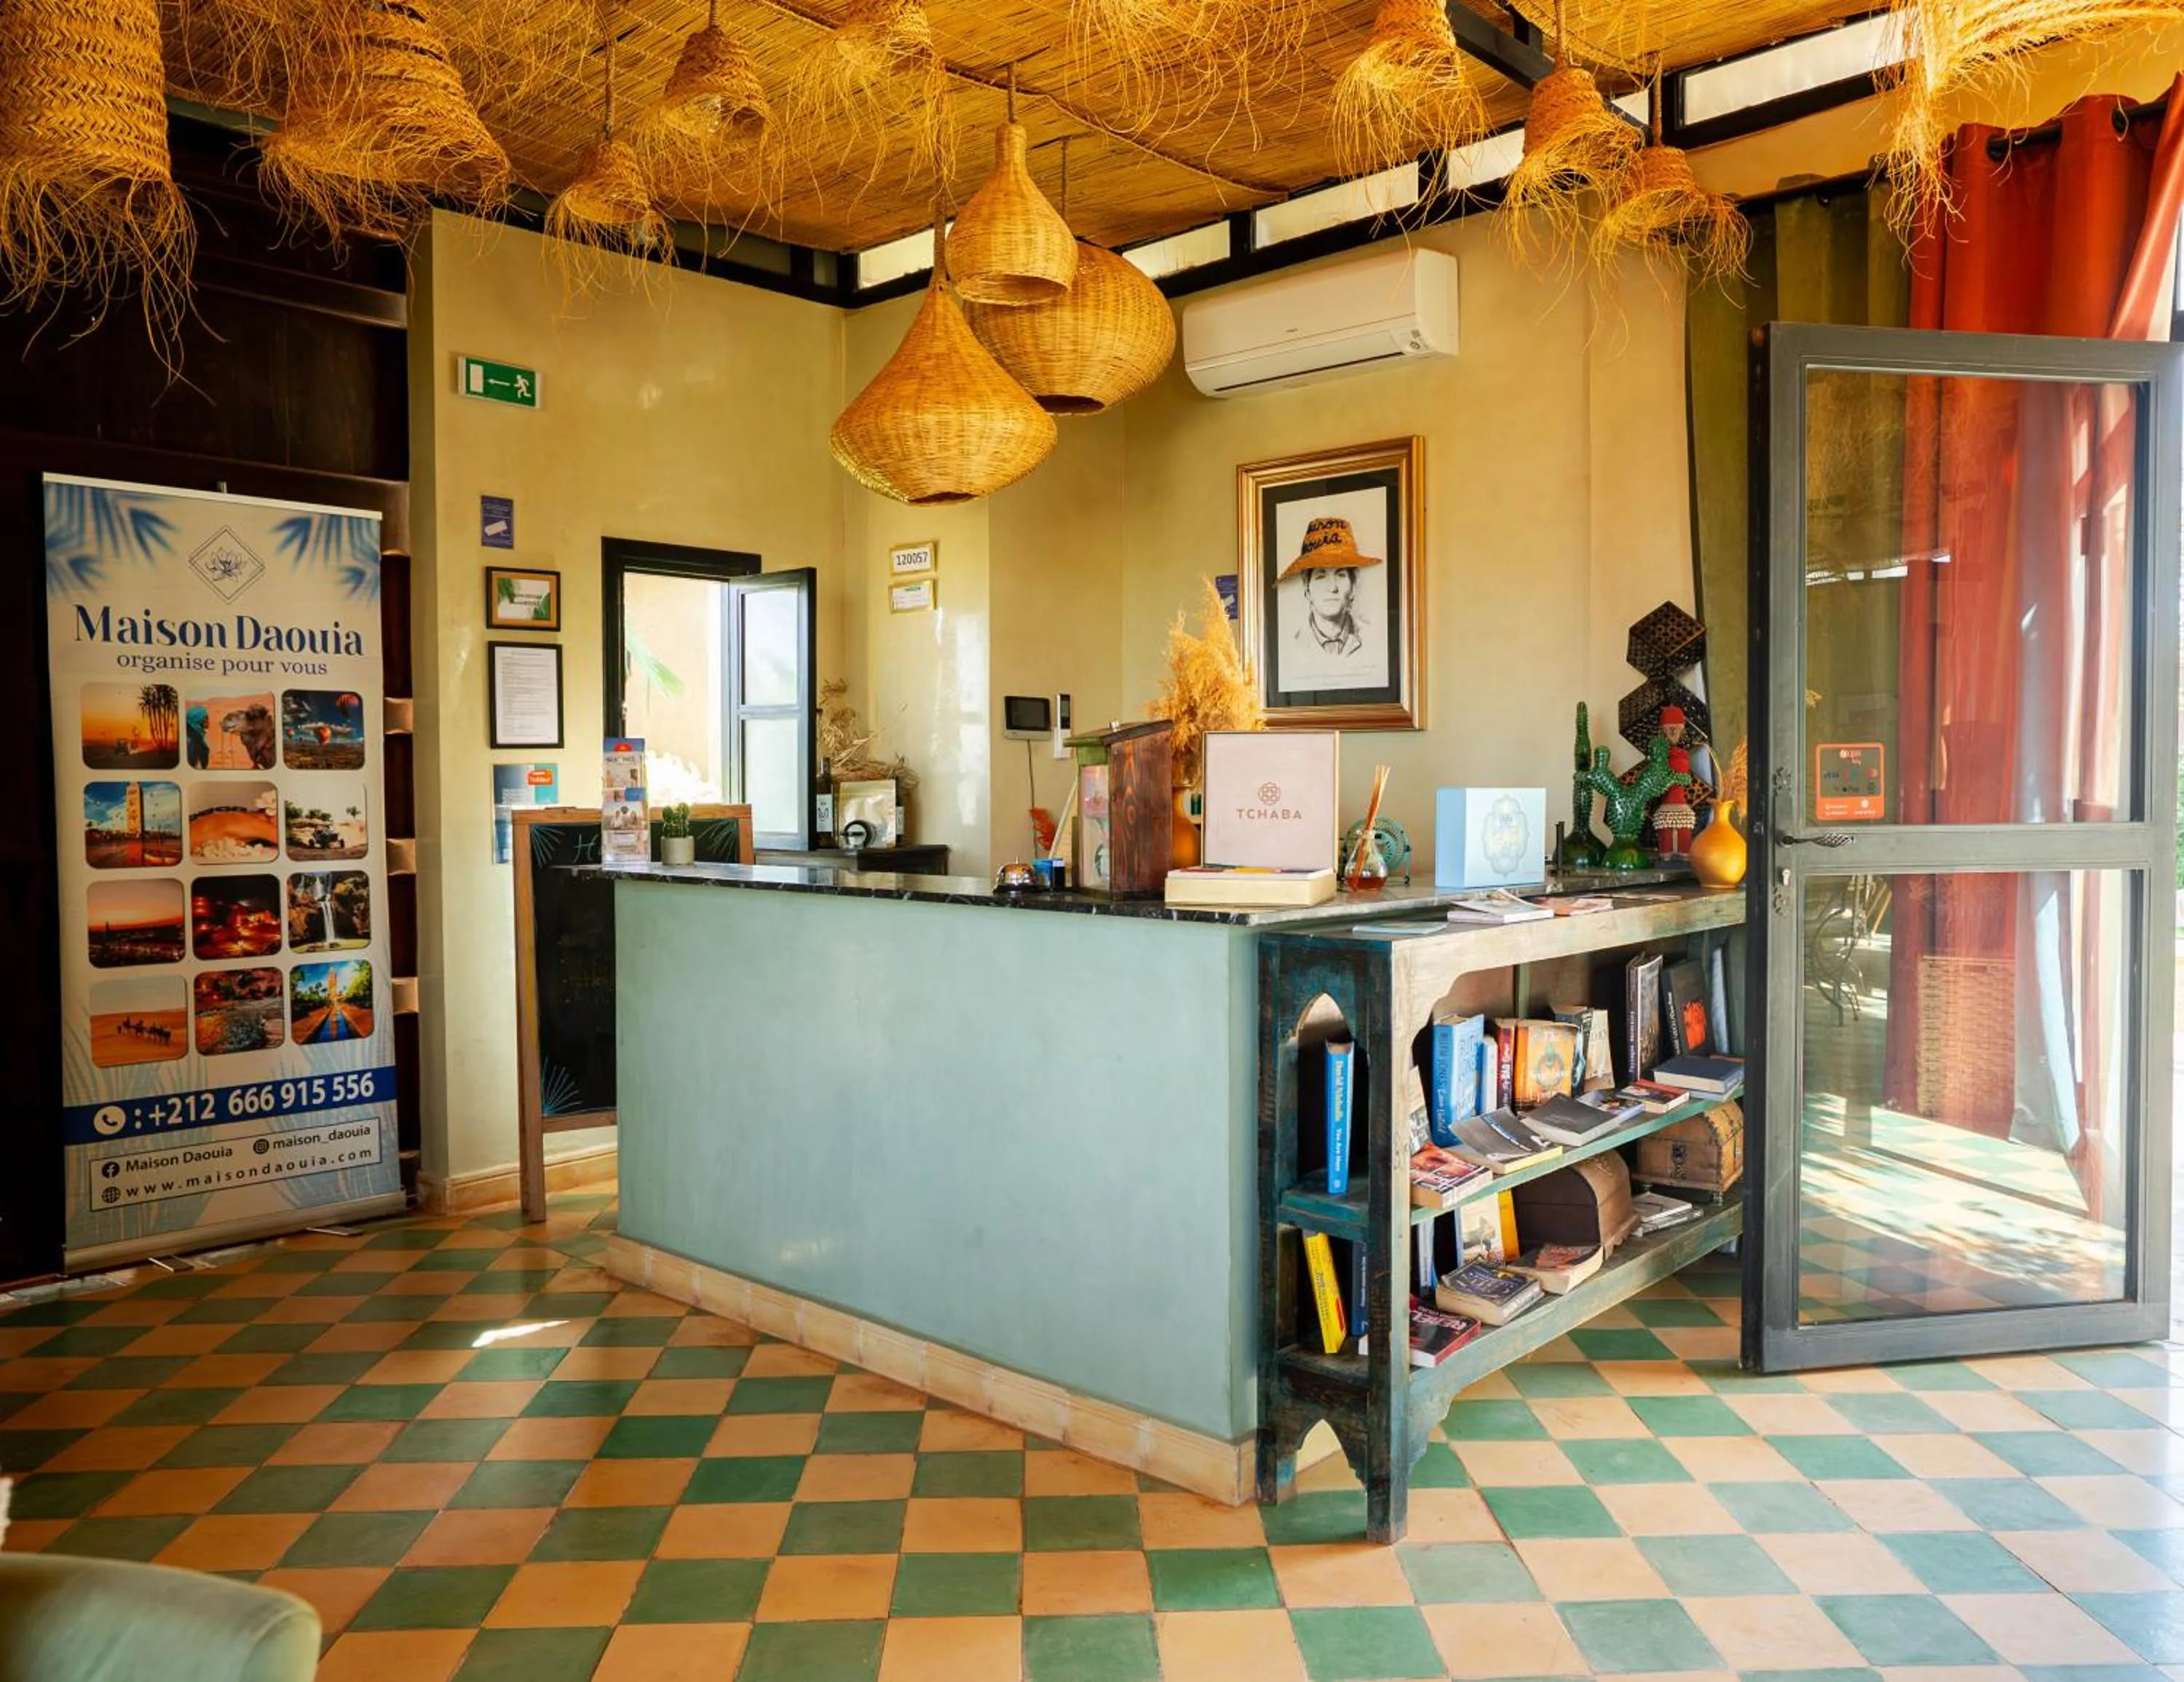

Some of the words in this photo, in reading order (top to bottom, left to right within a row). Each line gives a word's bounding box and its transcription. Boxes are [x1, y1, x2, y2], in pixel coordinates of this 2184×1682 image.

[74, 604, 226, 649] Maison
[236, 615, 363, 656] Daouia
[117, 652, 214, 673] organise
[222, 660, 274, 676] pour
[280, 660, 328, 674] vous
[1235, 808, 1302, 820] TCHABA
[149, 1093, 216, 1126] +212
[228, 1087, 275, 1117] 666
[280, 1078, 326, 1109] 915
[332, 1072, 375, 1102] 556
[273, 1125, 371, 1150] maison_daouia
[125, 1153, 180, 1173] Maison
[183, 1145, 234, 1165] Daouia
[126, 1148, 372, 1198] www.maisondaouia.com
